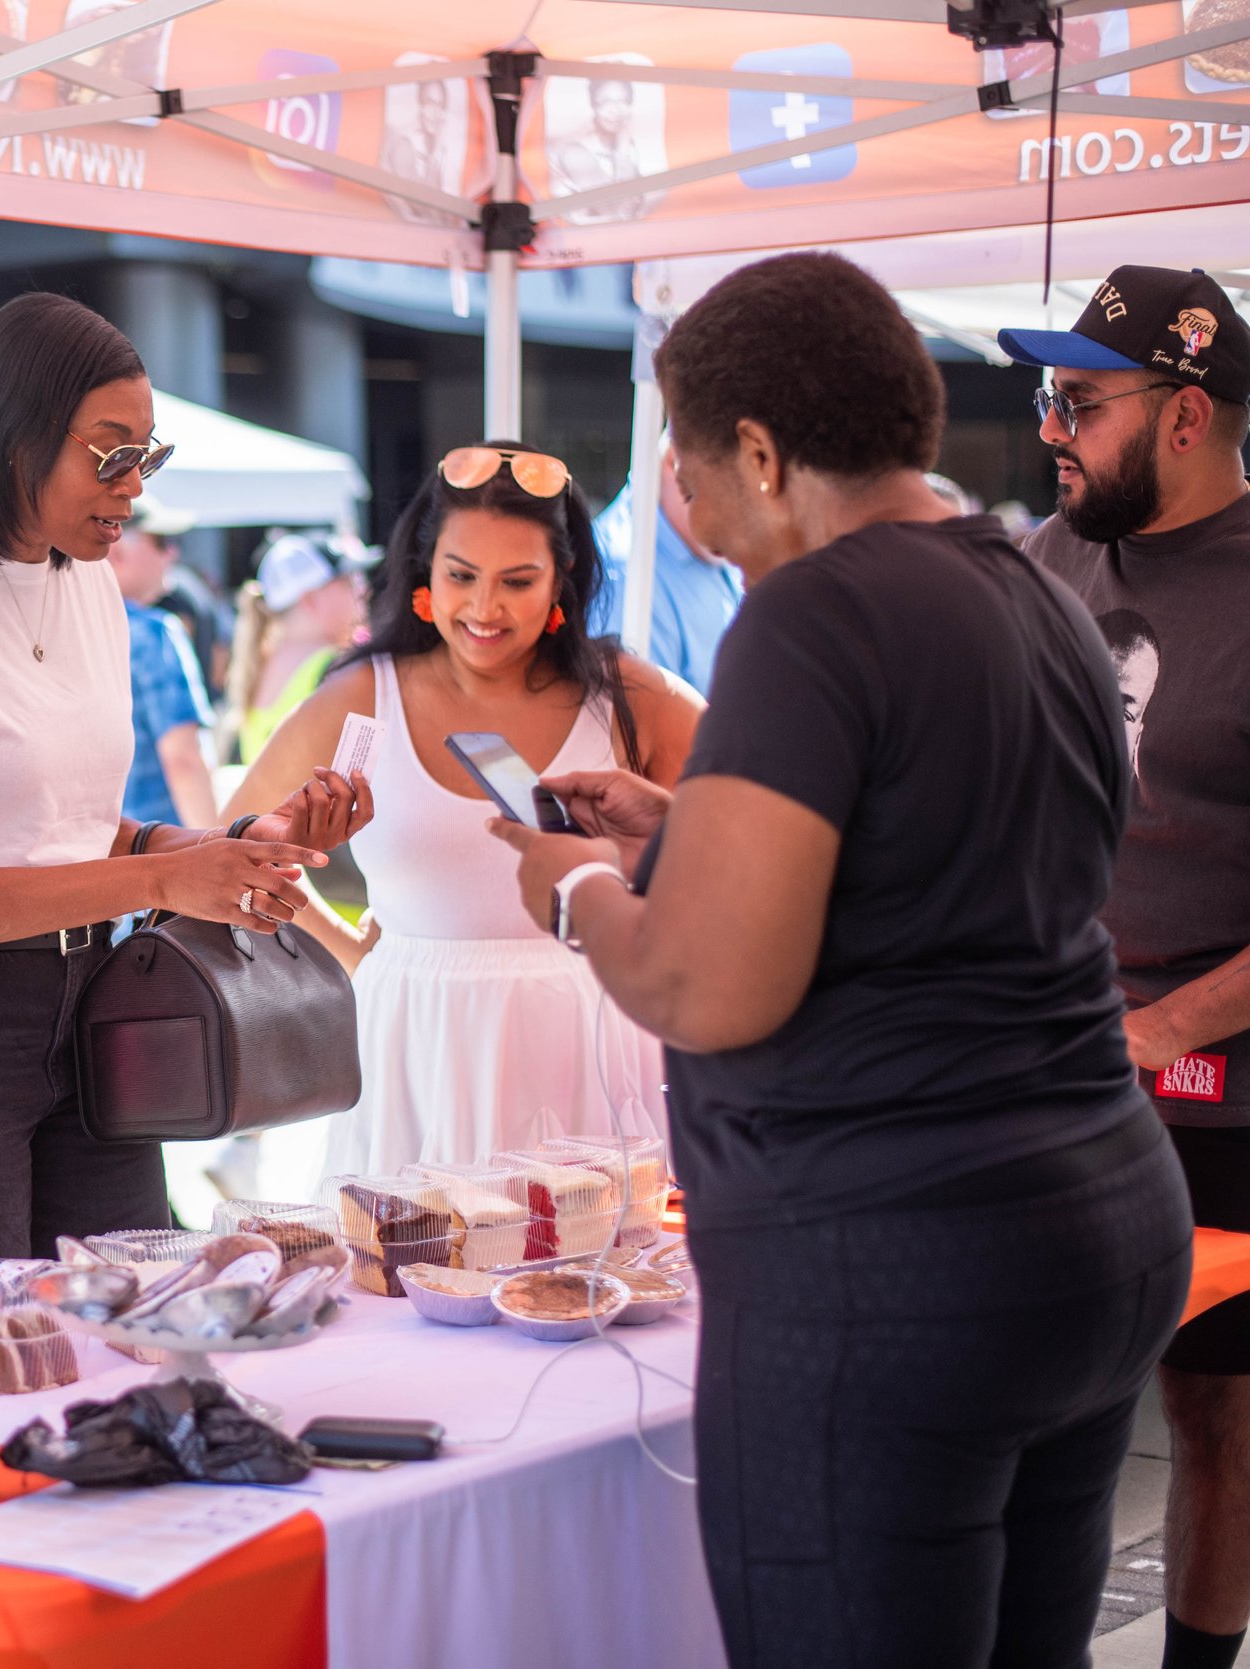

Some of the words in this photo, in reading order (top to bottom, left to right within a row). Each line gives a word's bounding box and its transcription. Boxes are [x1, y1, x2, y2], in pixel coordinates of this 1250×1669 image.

[1151, 349, 1174, 365] True
[1173, 1056, 1216, 1083] HATE
[1162, 1070, 1215, 1095] SNKRS
